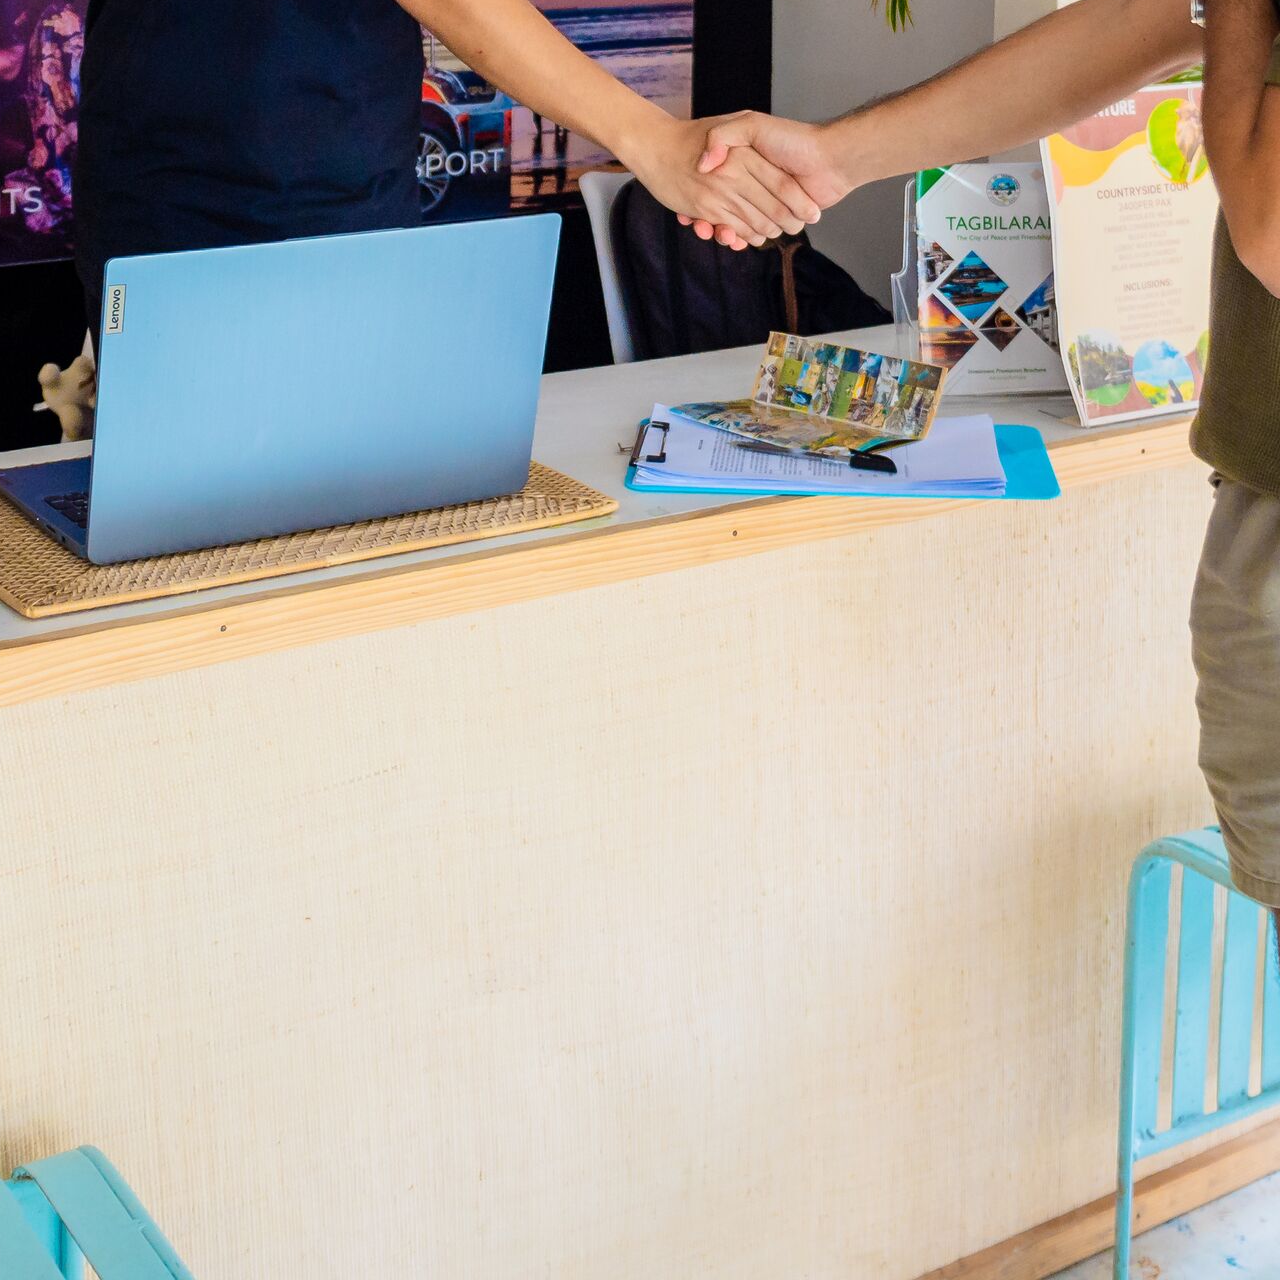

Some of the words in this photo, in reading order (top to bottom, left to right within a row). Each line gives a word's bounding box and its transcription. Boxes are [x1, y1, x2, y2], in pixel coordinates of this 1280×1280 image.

[1097, 184, 1161, 200] COUNTRYSIDE
[1164, 182, 1190, 193] TOUR
[969, 234, 981, 242] City
[109, 289, 121, 330] Lenovo
